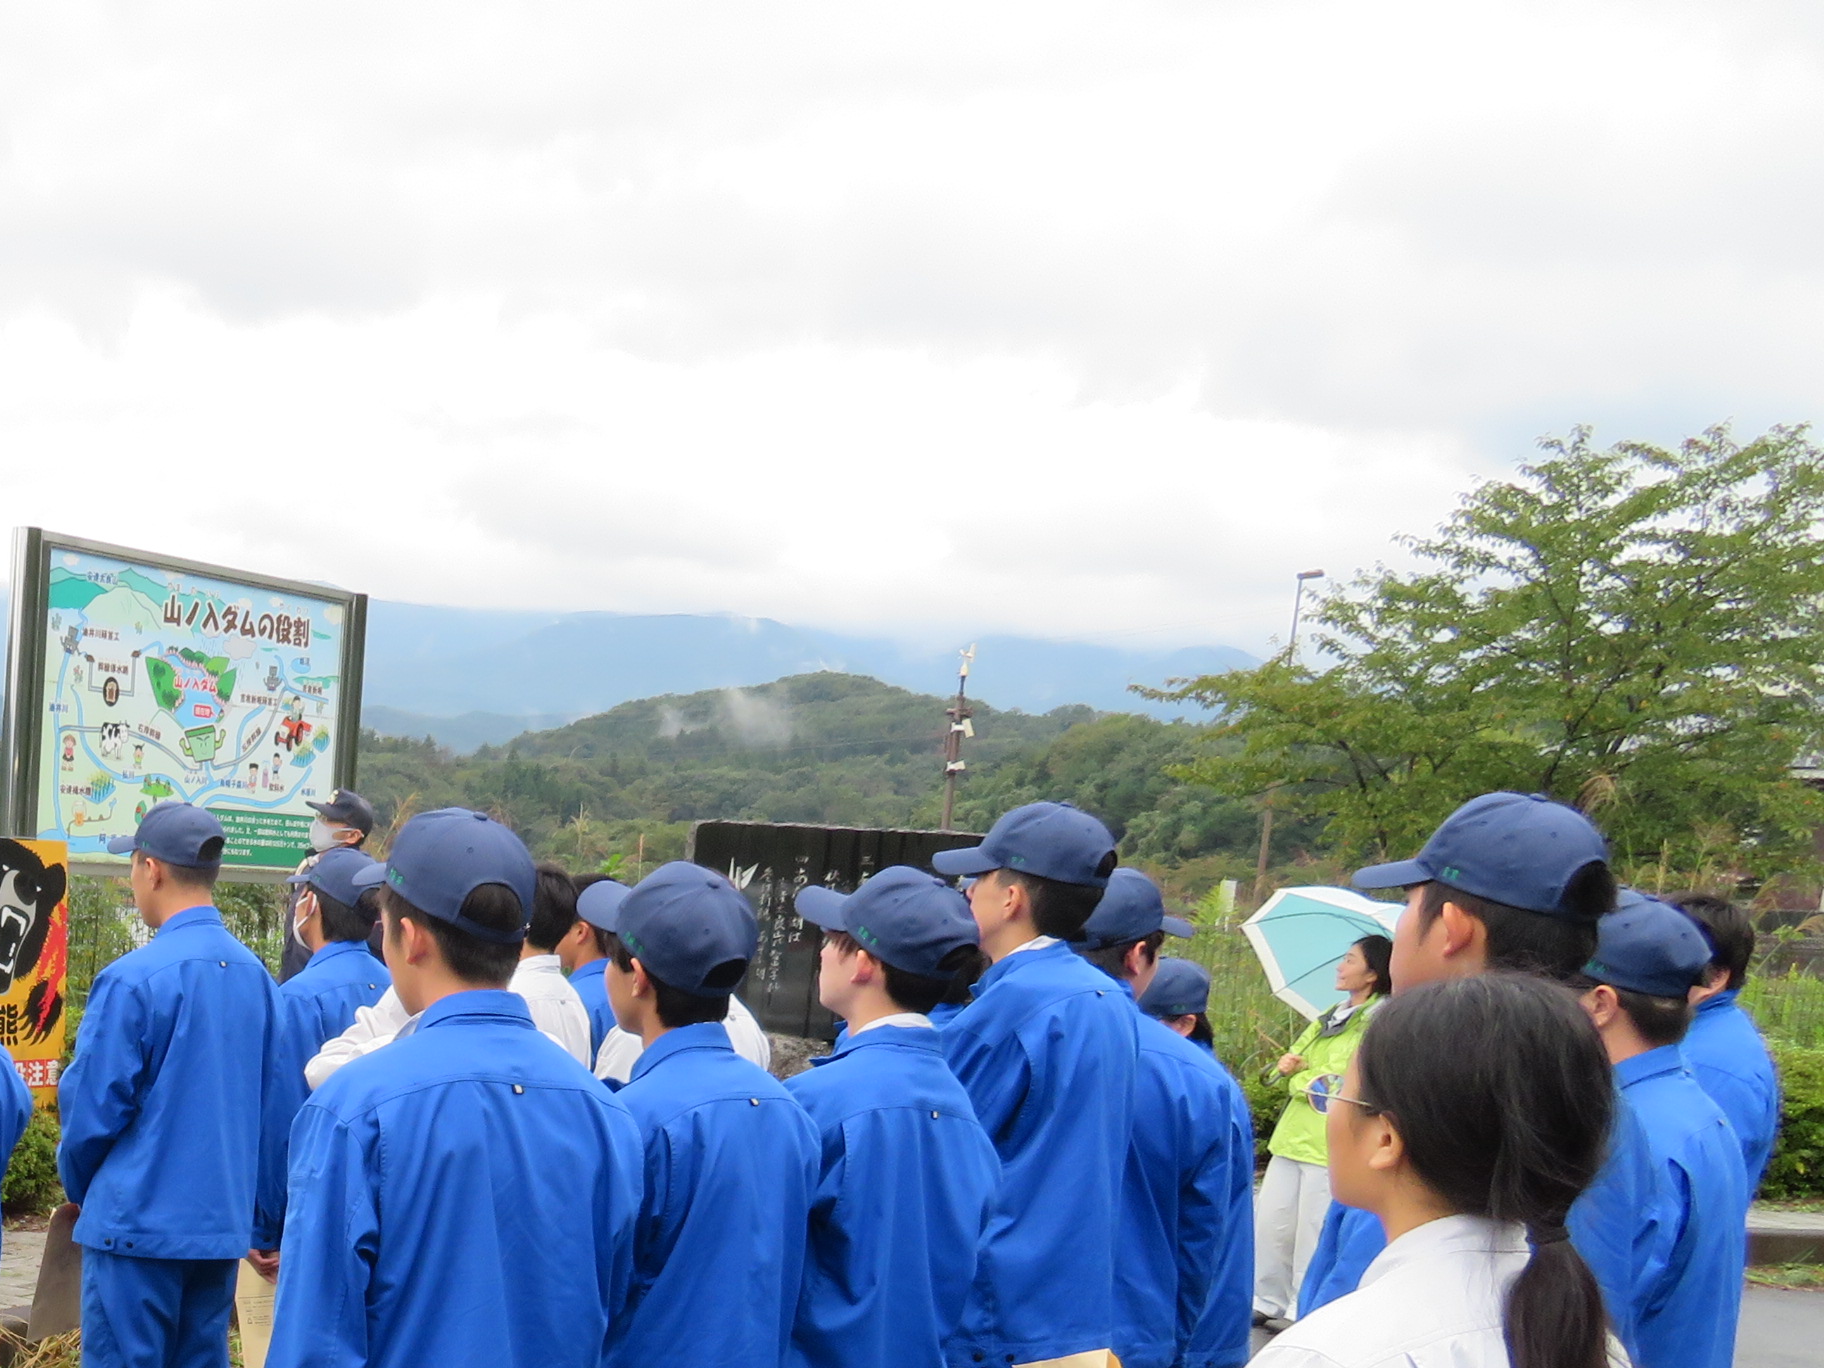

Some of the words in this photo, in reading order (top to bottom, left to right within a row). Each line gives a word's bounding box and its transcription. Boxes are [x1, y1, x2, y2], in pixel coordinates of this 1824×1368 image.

[163, 594, 310, 648] 山ノ入ダムの役割
[174, 676, 218, 693] 山ノ入ダム
